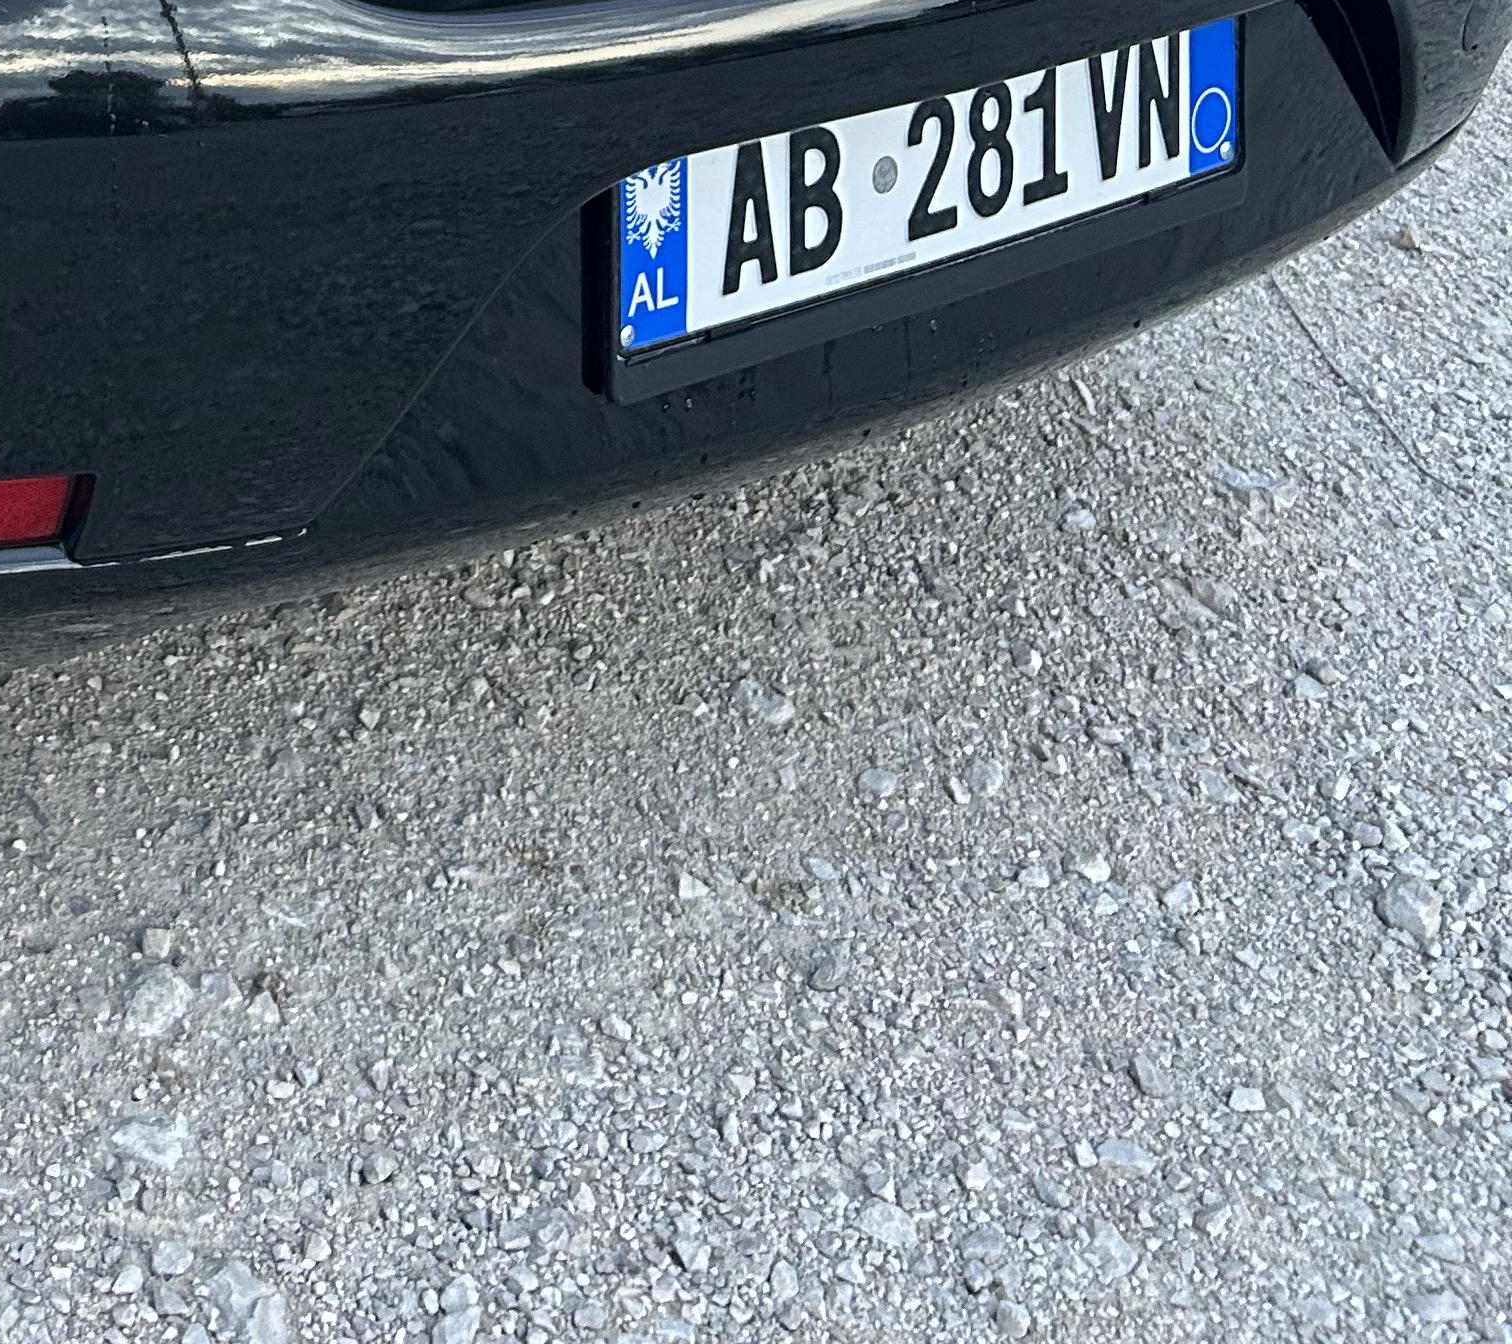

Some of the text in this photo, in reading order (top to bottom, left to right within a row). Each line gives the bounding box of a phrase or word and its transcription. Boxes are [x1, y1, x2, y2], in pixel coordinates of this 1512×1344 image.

[721, 32, 1180, 297] AB 281 VN
[627, 266, 679, 318] AL
